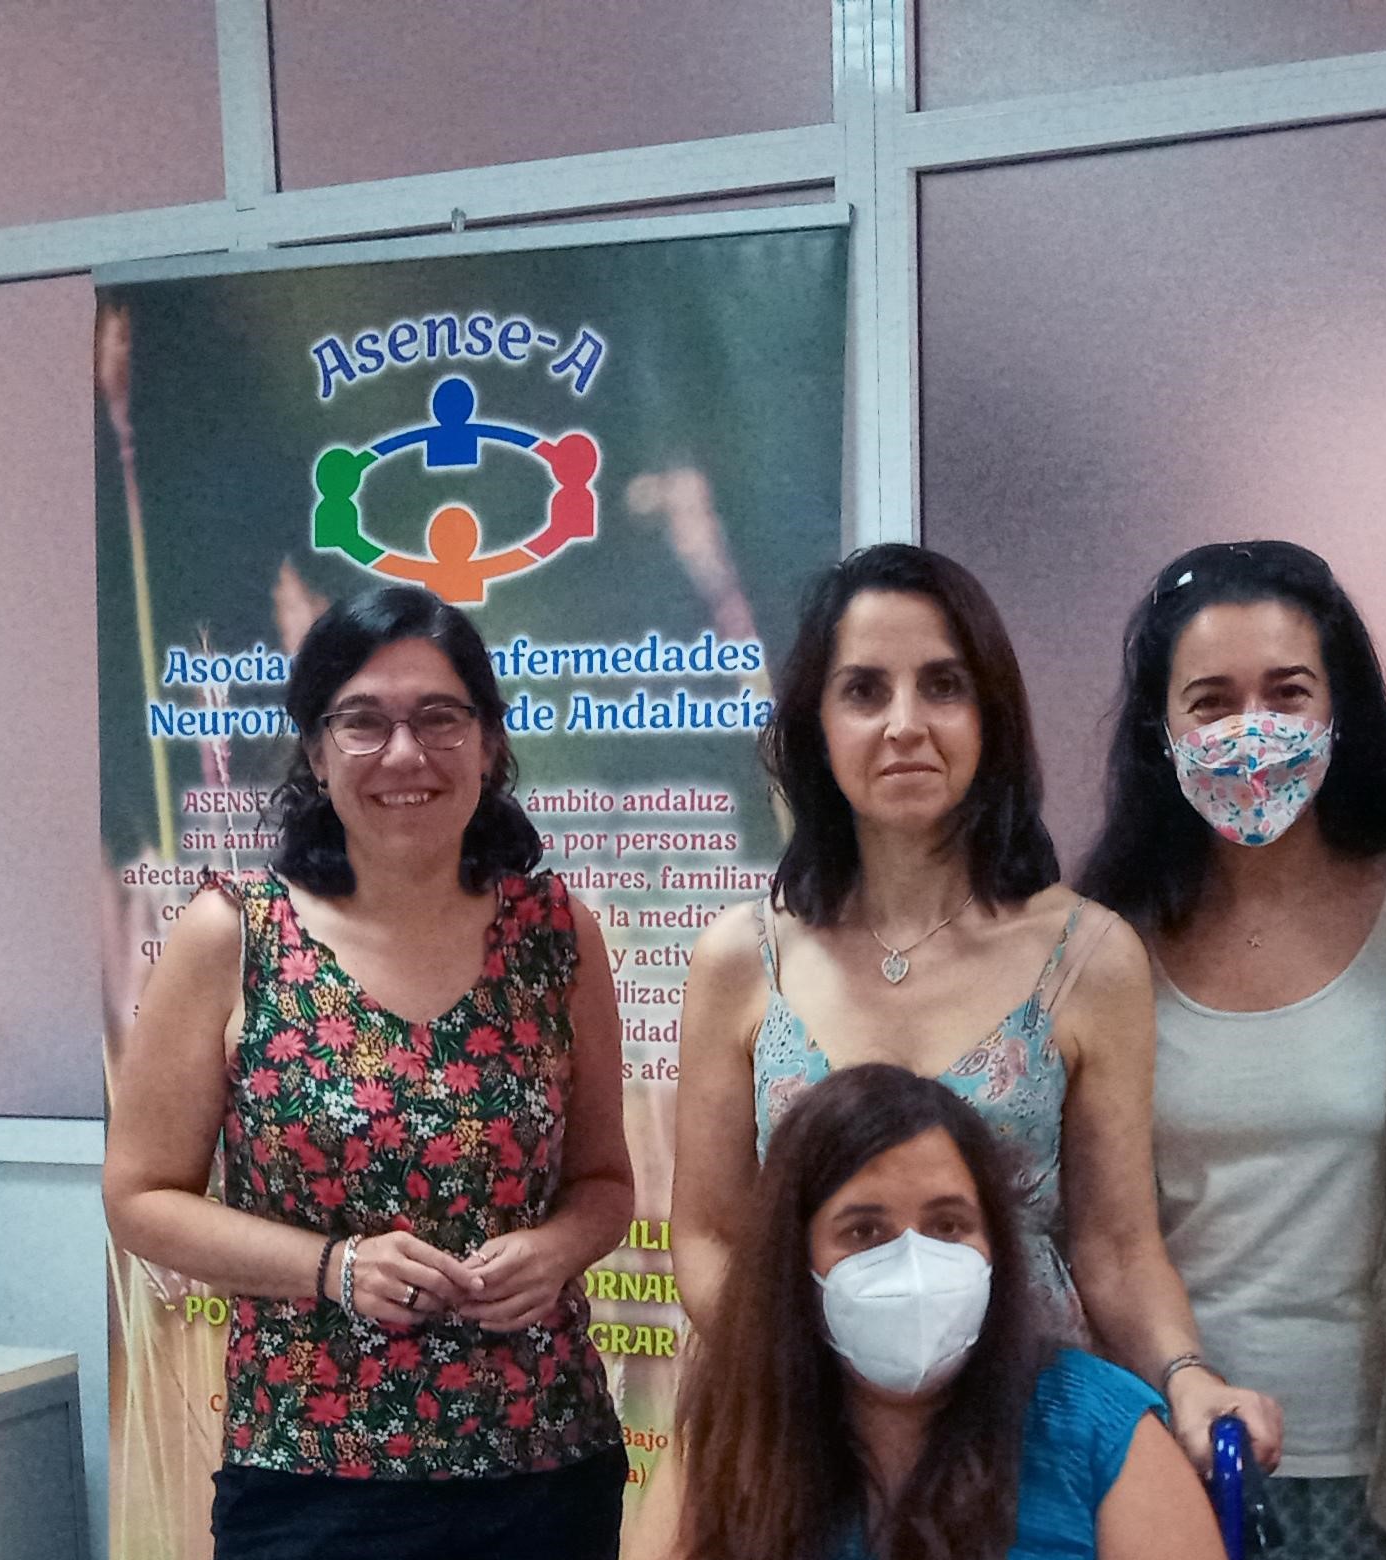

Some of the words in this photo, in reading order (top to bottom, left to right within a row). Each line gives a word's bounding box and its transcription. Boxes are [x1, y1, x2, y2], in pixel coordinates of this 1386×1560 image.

[312, 315, 603, 399] Asense-A
[506, 695, 554, 731] de
[566, 689, 773, 731] Andalucía
[527, 787, 614, 813] ámbito
[183, 828, 217, 850] sin
[564, 833, 608, 859] por
[616, 832, 738, 859] personas
[609, 904, 630, 927] la
[611, 948, 627, 974] y
[185, 1295, 229, 1326] PO
